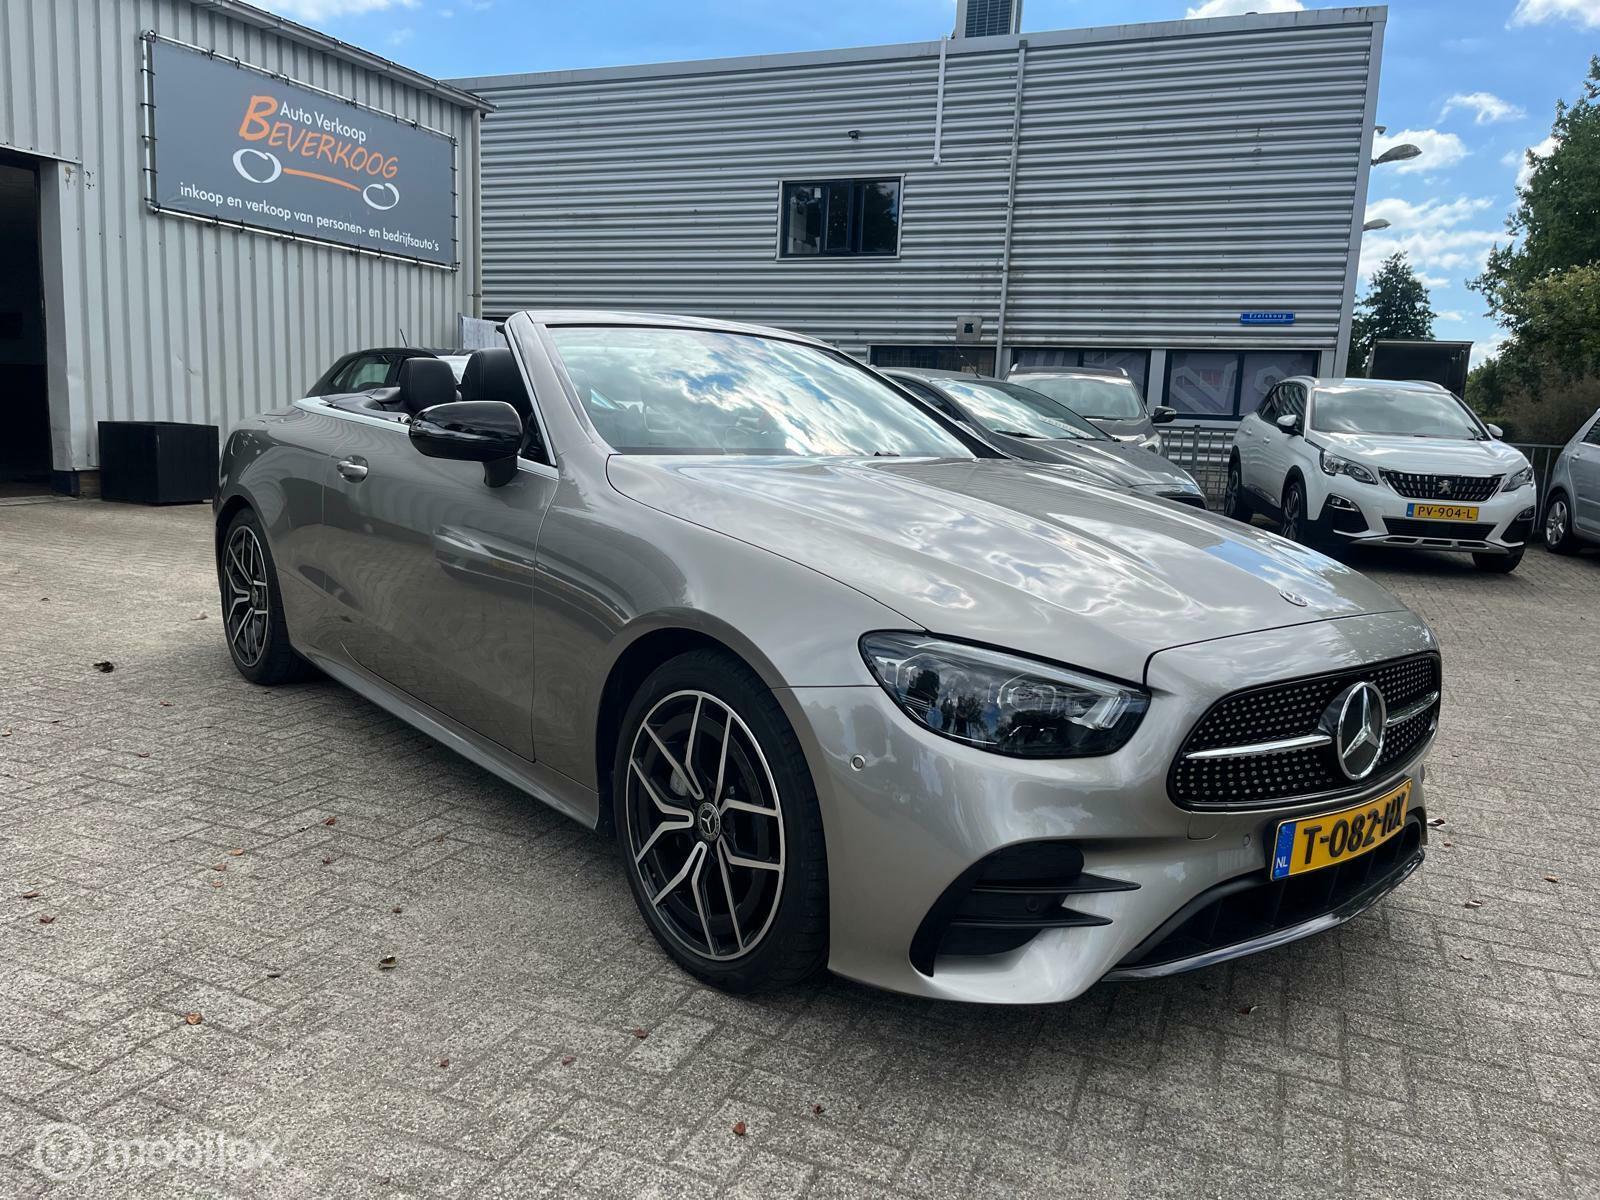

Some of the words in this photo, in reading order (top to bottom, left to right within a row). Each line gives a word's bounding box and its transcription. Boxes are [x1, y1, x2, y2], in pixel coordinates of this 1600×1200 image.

[239, 95, 399, 179] BEVERKOOG
[280, 101, 312, 125] Auto
[314, 111, 367, 144] Verkoop
[180, 182, 224, 207] inkoop
[227, 196, 242, 208] en
[245, 200, 291, 221] verkoop
[293, 211, 314, 224] van
[316, 216, 366, 235] personen-
[368, 228, 381, 239] en
[1417, 505, 1473, 519] PV-904-L
[1275, 855, 1289, 869] NL
